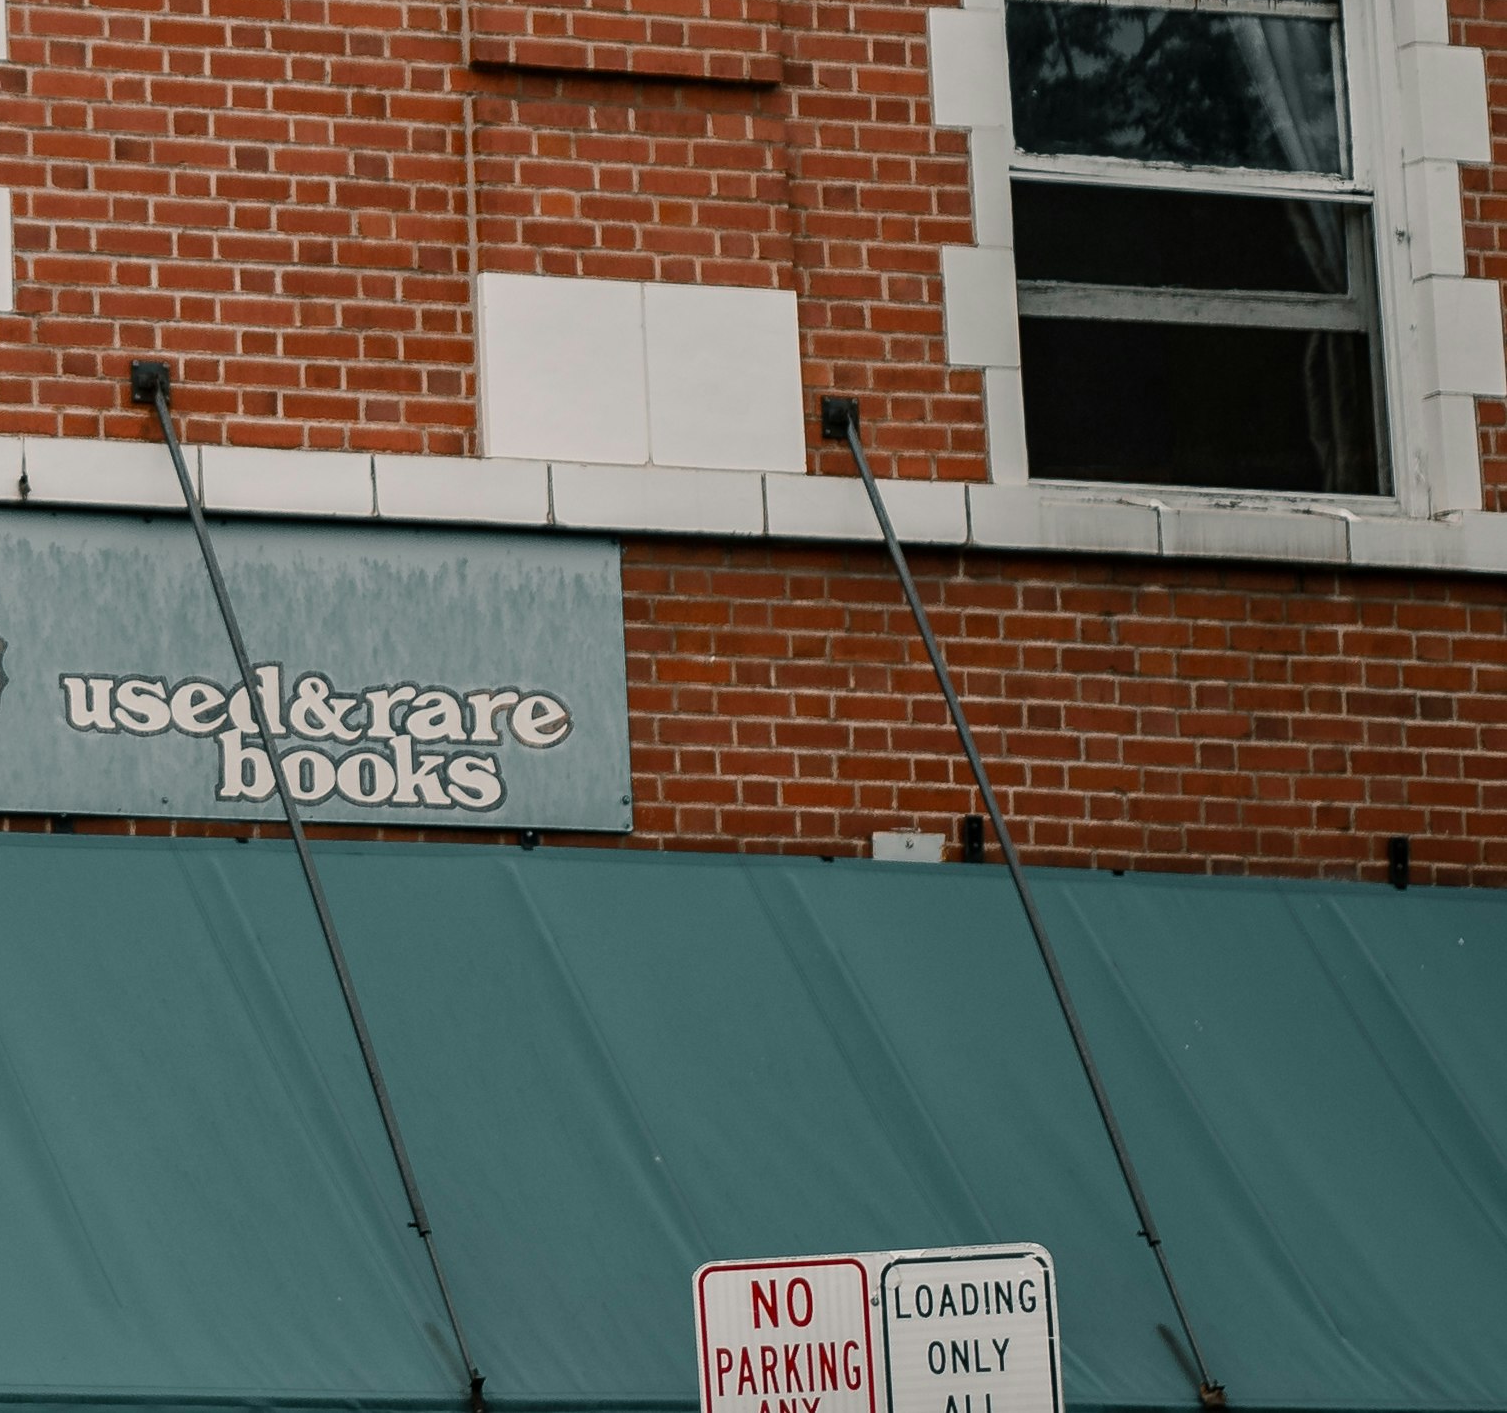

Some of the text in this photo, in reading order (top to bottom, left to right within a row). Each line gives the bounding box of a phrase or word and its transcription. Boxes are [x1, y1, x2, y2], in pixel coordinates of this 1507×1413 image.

[215, 731, 506, 812] books
[751, 1277, 814, 1329] NO
[895, 1279, 1038, 1319] LOADING
[716, 1340, 862, 1397] PARKING
[928, 1338, 1010, 1375] ONLY
